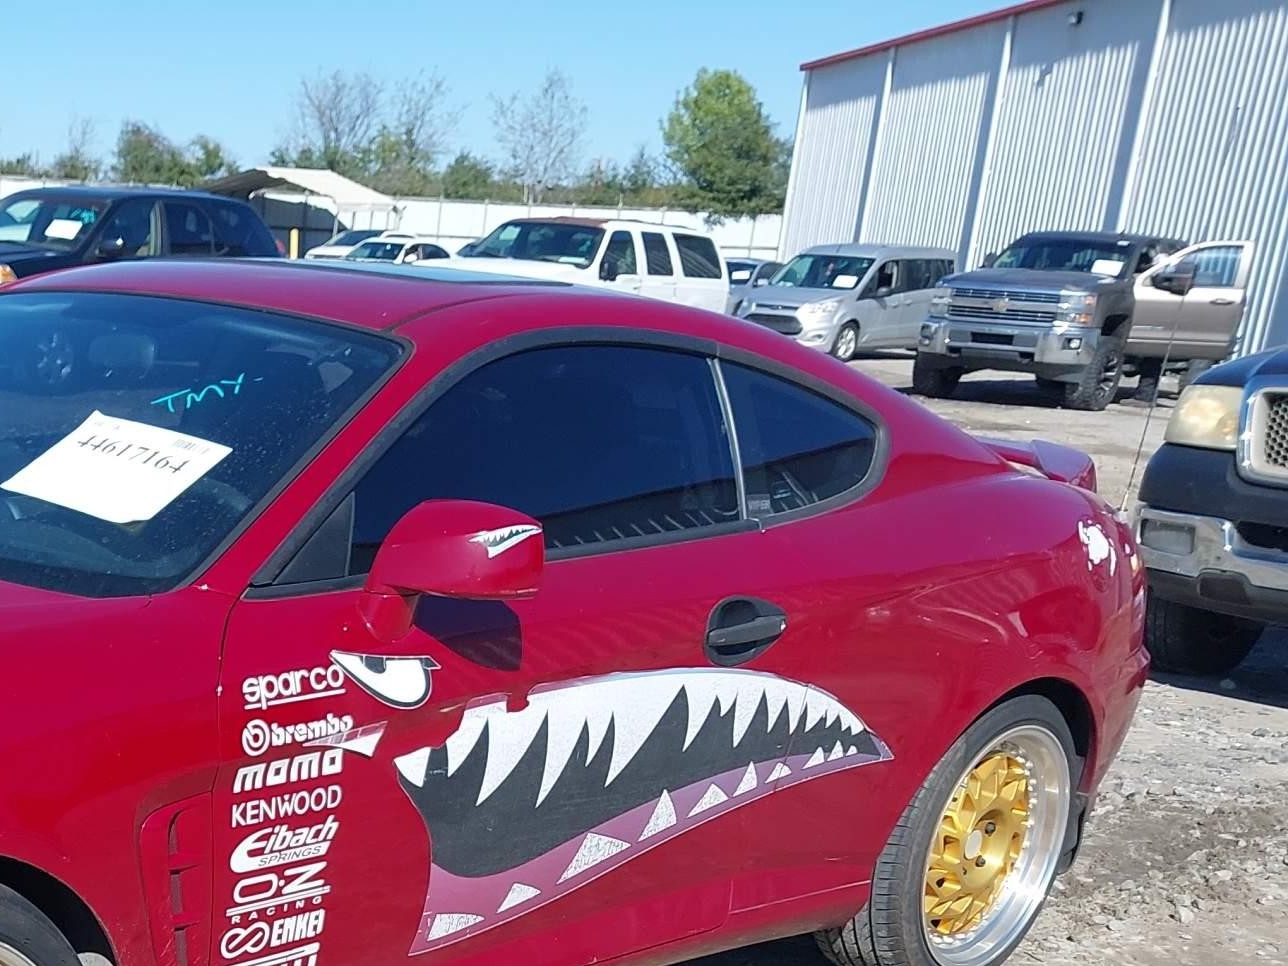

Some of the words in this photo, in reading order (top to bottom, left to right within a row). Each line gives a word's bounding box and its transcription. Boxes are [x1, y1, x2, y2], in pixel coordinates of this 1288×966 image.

[76, 434, 190, 474] 44617164
[242, 664, 345, 710] sparco
[271, 712, 354, 746] brembo
[232, 748, 344, 794] momo
[231, 784, 343, 828] KENWOOD
[230, 814, 340, 873] Eibach
[258, 845, 322, 867] SPRINGS
[231, 895, 323, 925] RACING
[270, 908, 326, 948] ENKEI
